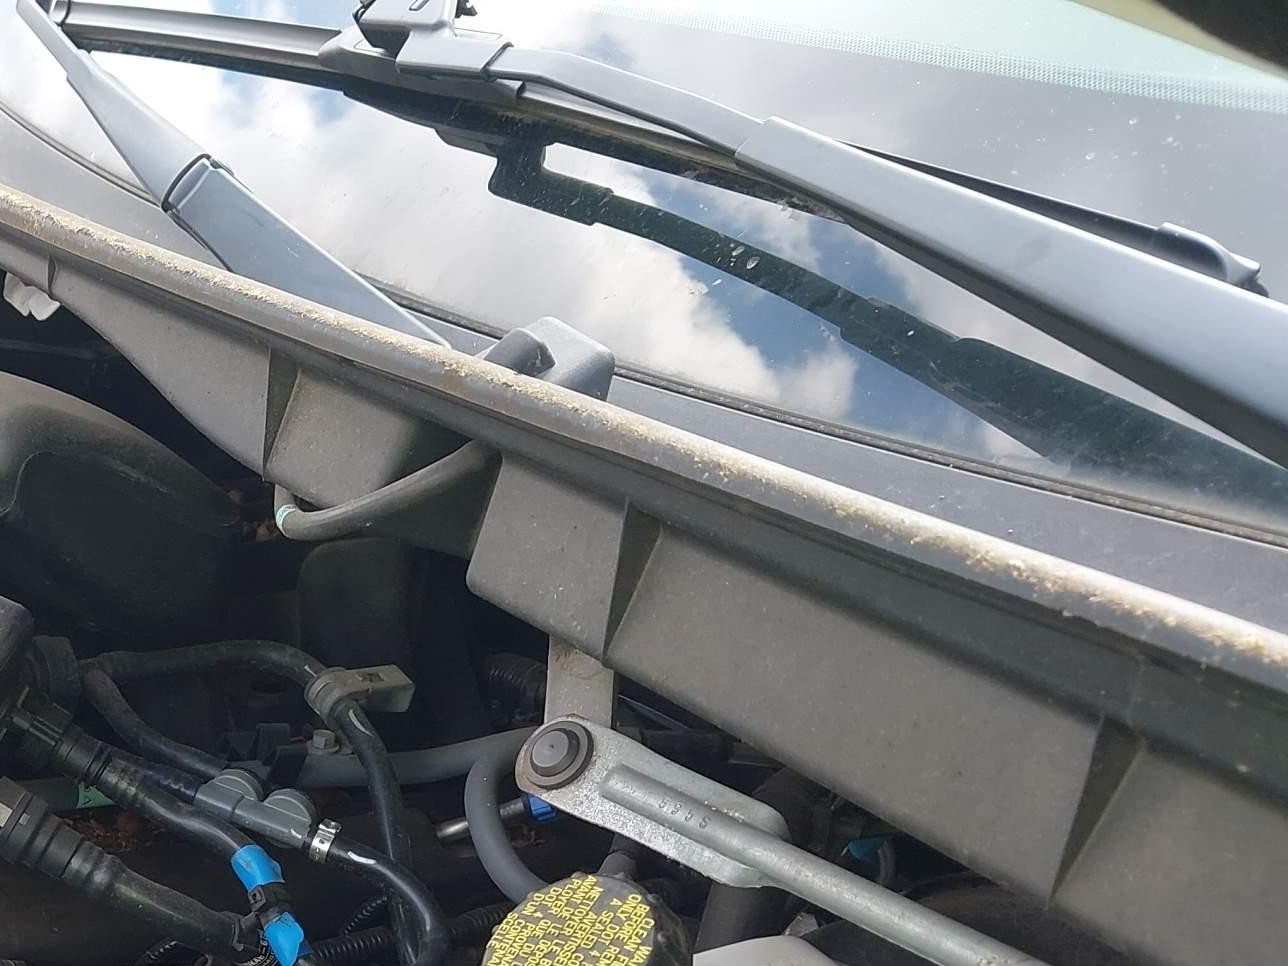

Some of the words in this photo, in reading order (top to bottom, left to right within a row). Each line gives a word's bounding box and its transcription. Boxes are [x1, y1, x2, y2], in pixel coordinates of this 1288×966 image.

[541, 887, 562, 906] DOT
[547, 879, 581, 915] PLOYER
[570, 874, 596, 904] AVANT
[521, 893, 544, 915] D'UN
[559, 886, 603, 935] NETTOYER
[609, 897, 622, 905] A
[615, 894, 641, 920] ONLY
[556, 906, 573, 920] DE
[614, 903, 650, 942] BEFORE
[530, 918, 551, 939] QUE
[546, 922, 562, 936] LE
[579, 910, 614, 949] SEALED
[598, 924, 619, 945] DOT
[622, 917, 655, 952] CLEAN
[518, 942, 534, 957] DU
[547, 938, 564, 954] LE
